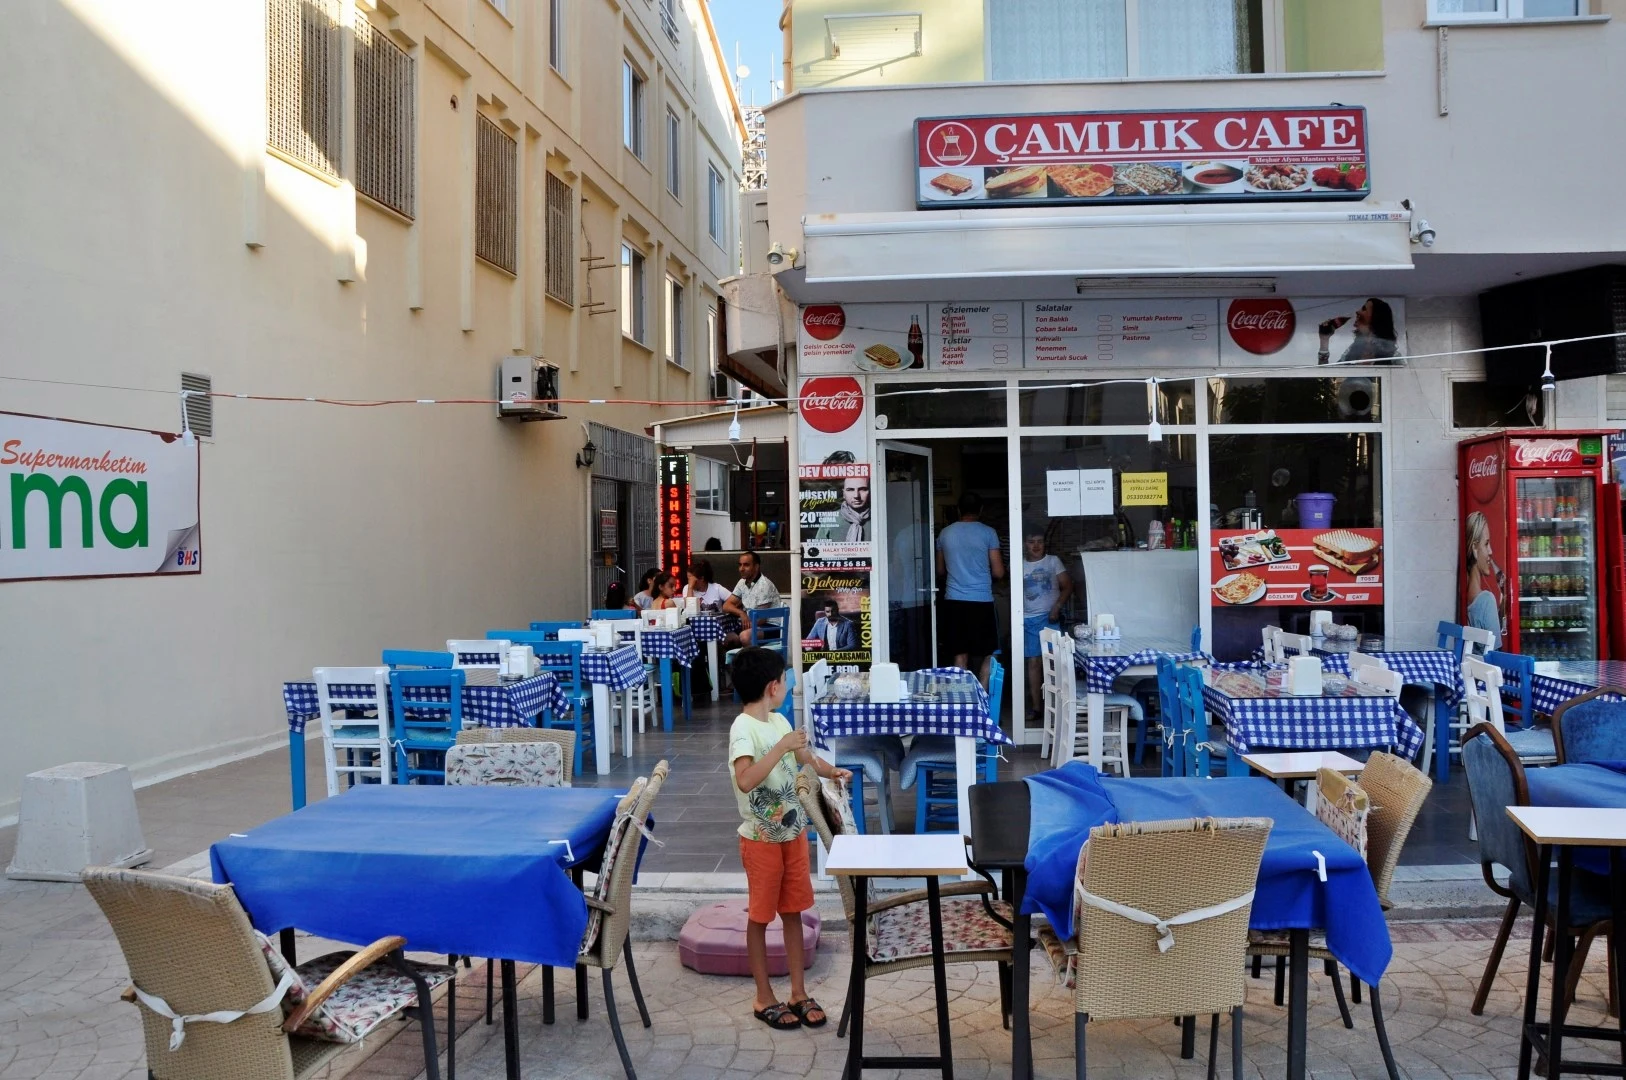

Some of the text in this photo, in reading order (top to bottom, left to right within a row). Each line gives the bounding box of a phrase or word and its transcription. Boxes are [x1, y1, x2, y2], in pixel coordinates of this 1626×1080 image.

[984, 115, 1357, 163] ÇAMLIK CAFE
[1035, 304, 1073, 312] Salatalar
[942, 337, 972, 345] Tostlar
[1, 439, 148, 474] Supermarketim
[799, 465, 869, 477] DEV KONSER
[0, 472, 148, 550] ma
[800, 511, 816, 524] 20
[177, 550, 198, 566] BHS
[802, 576, 862, 594] Yakamoz
[860, 596, 872, 648] KONSER
[807, 652, 833, 661] TEMMUZ
[835, 652, 870, 661] ÇARŞAMBA
